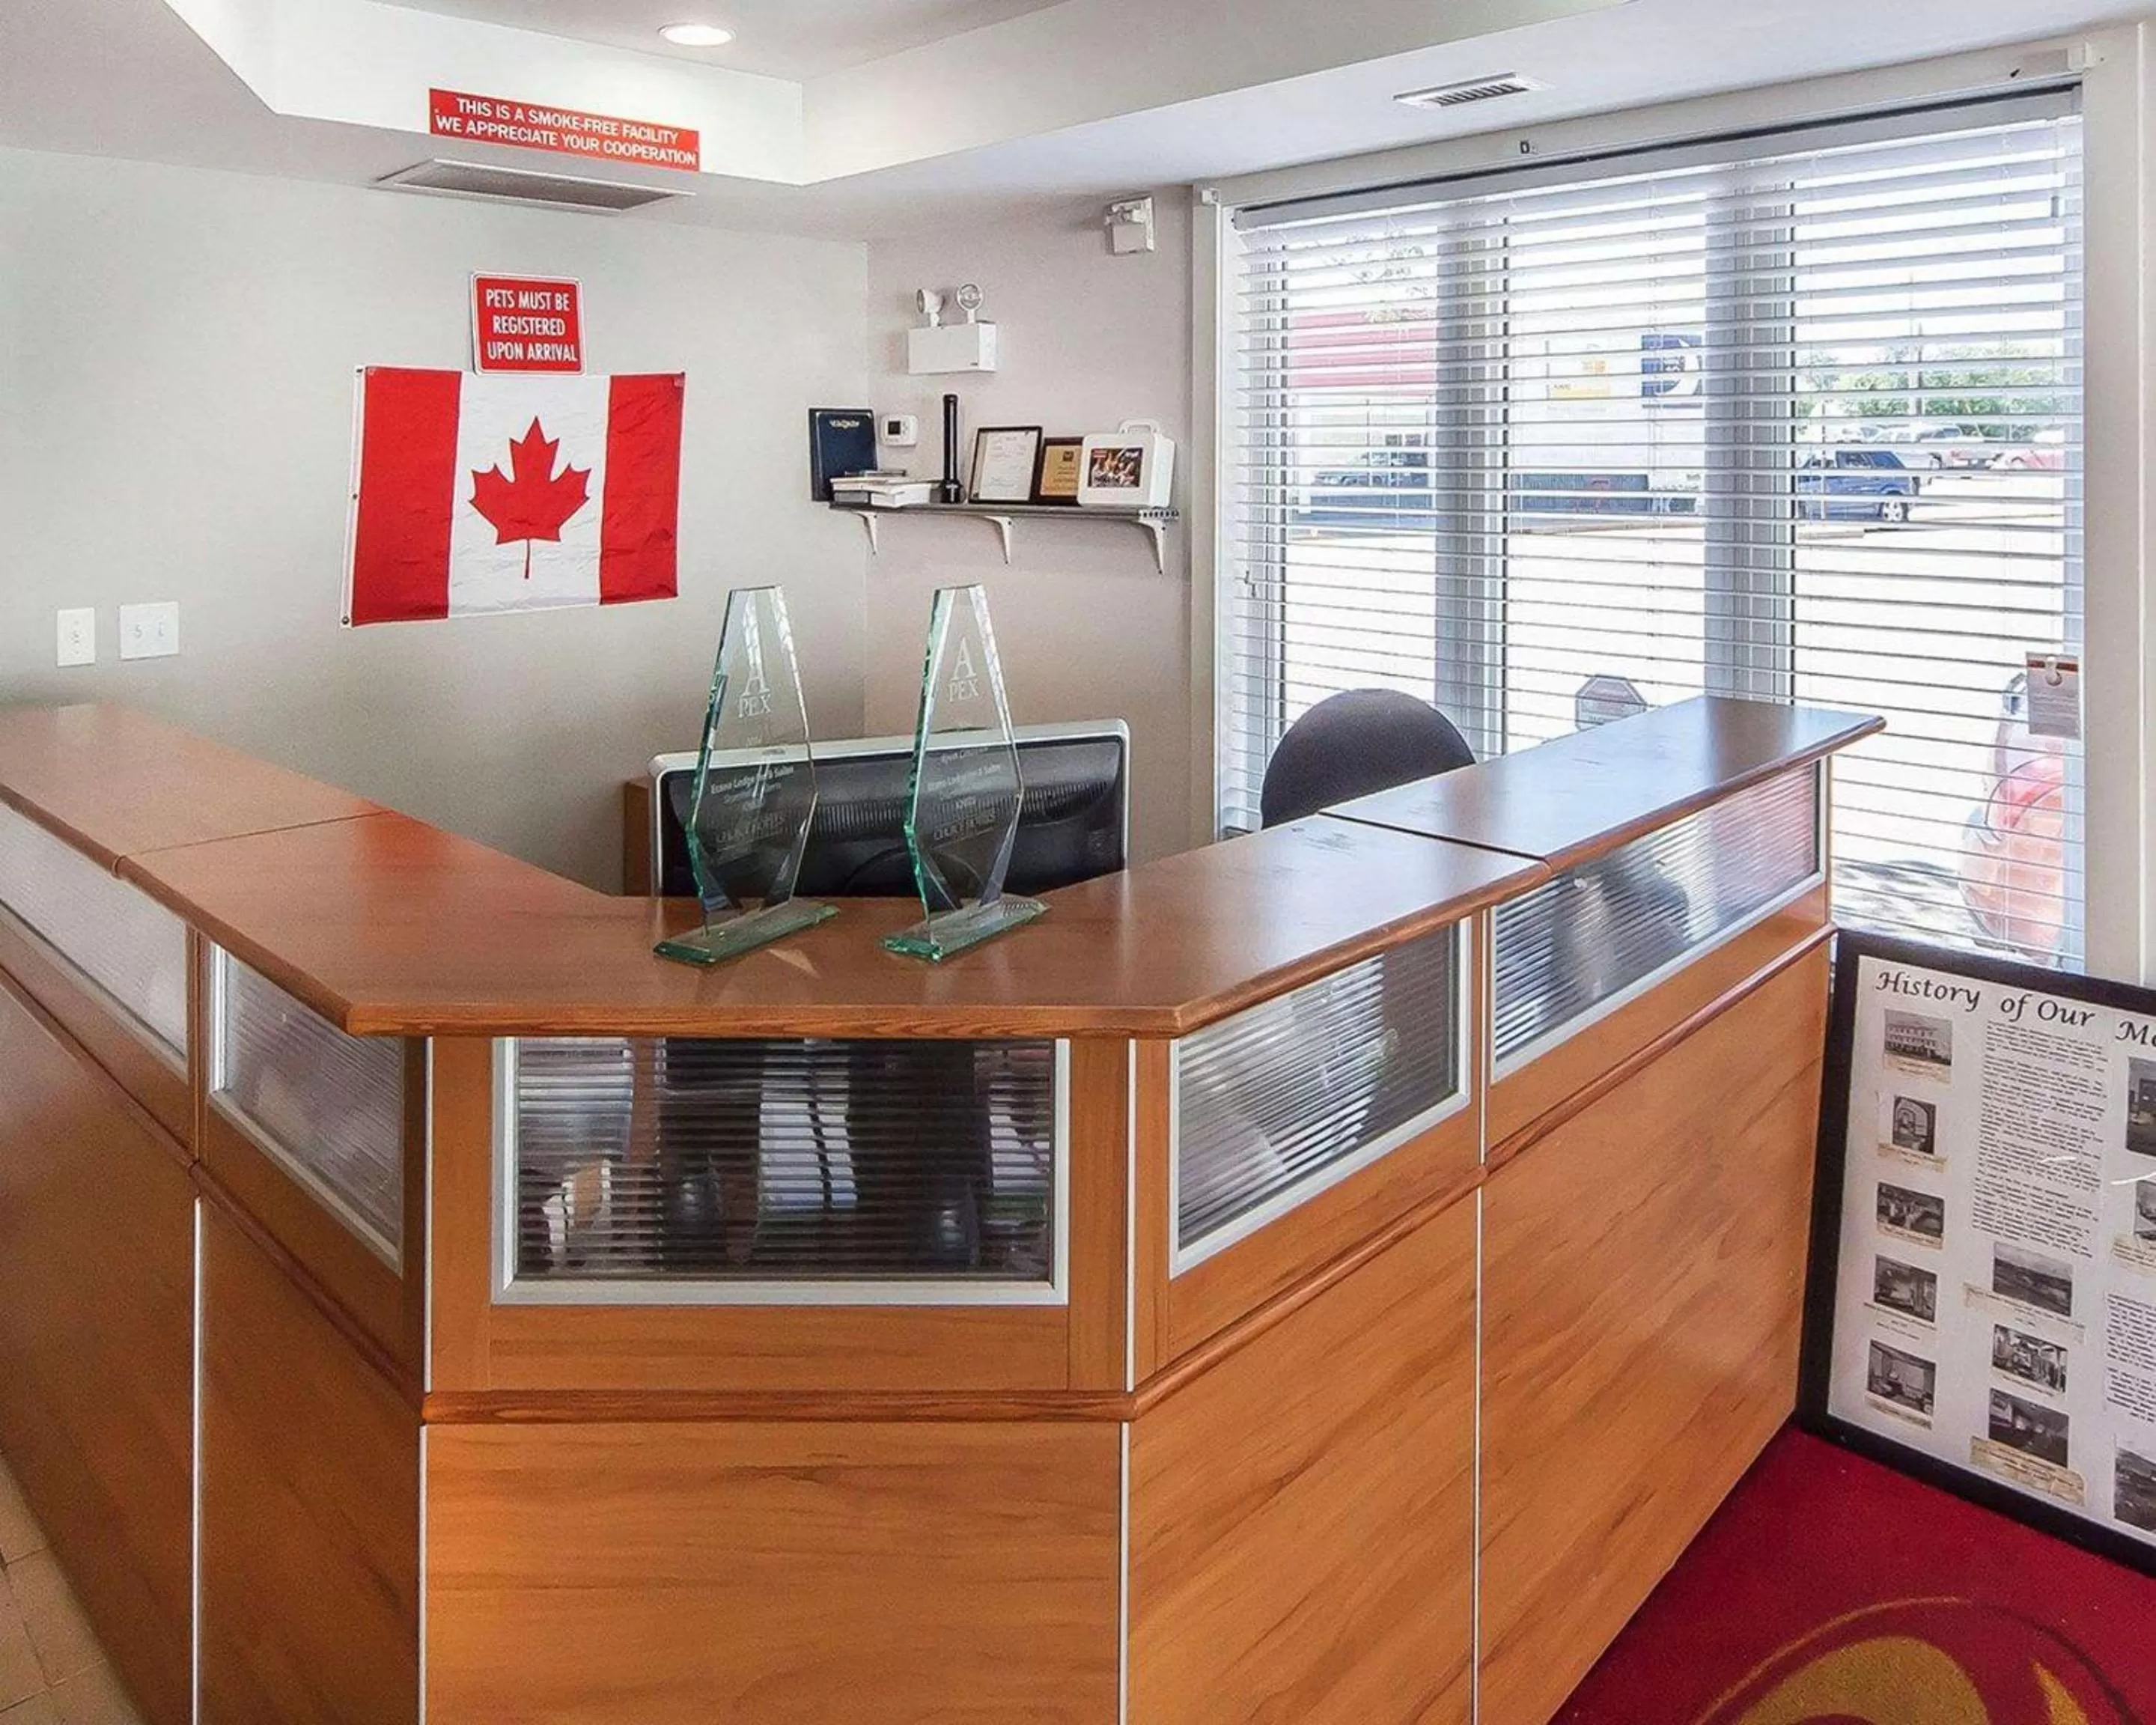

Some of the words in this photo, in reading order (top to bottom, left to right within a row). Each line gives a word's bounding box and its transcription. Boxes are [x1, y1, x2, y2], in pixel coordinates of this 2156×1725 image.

[456, 97, 491, 117] THIS
[496, 104, 510, 120] IS
[514, 108, 524, 121] A
[528, 109, 619, 136] SMOKE-FREE
[622, 124, 678, 144] FACILITY
[435, 115, 462, 133] WE
[466, 120, 558, 146] APPRECIATE
[562, 133, 599, 151] YOUR
[603, 139, 697, 165] COOPERATION
[486, 288, 515, 308] PETS
[518, 290, 552, 310] MUST
[555, 293, 570, 311] BE
[493, 314, 565, 336] REGISTERED
[487, 341, 523, 360] UPON
[527, 343, 578, 362] ARRIVAL
[951, 636, 977, 681] A
[948, 678, 979, 702] PEX
[738, 693, 771, 719] PEX
[1875, 971, 1981, 1013] History
[2000, 994, 2032, 1022] of
[2038, 1000, 2096, 1027] Our
